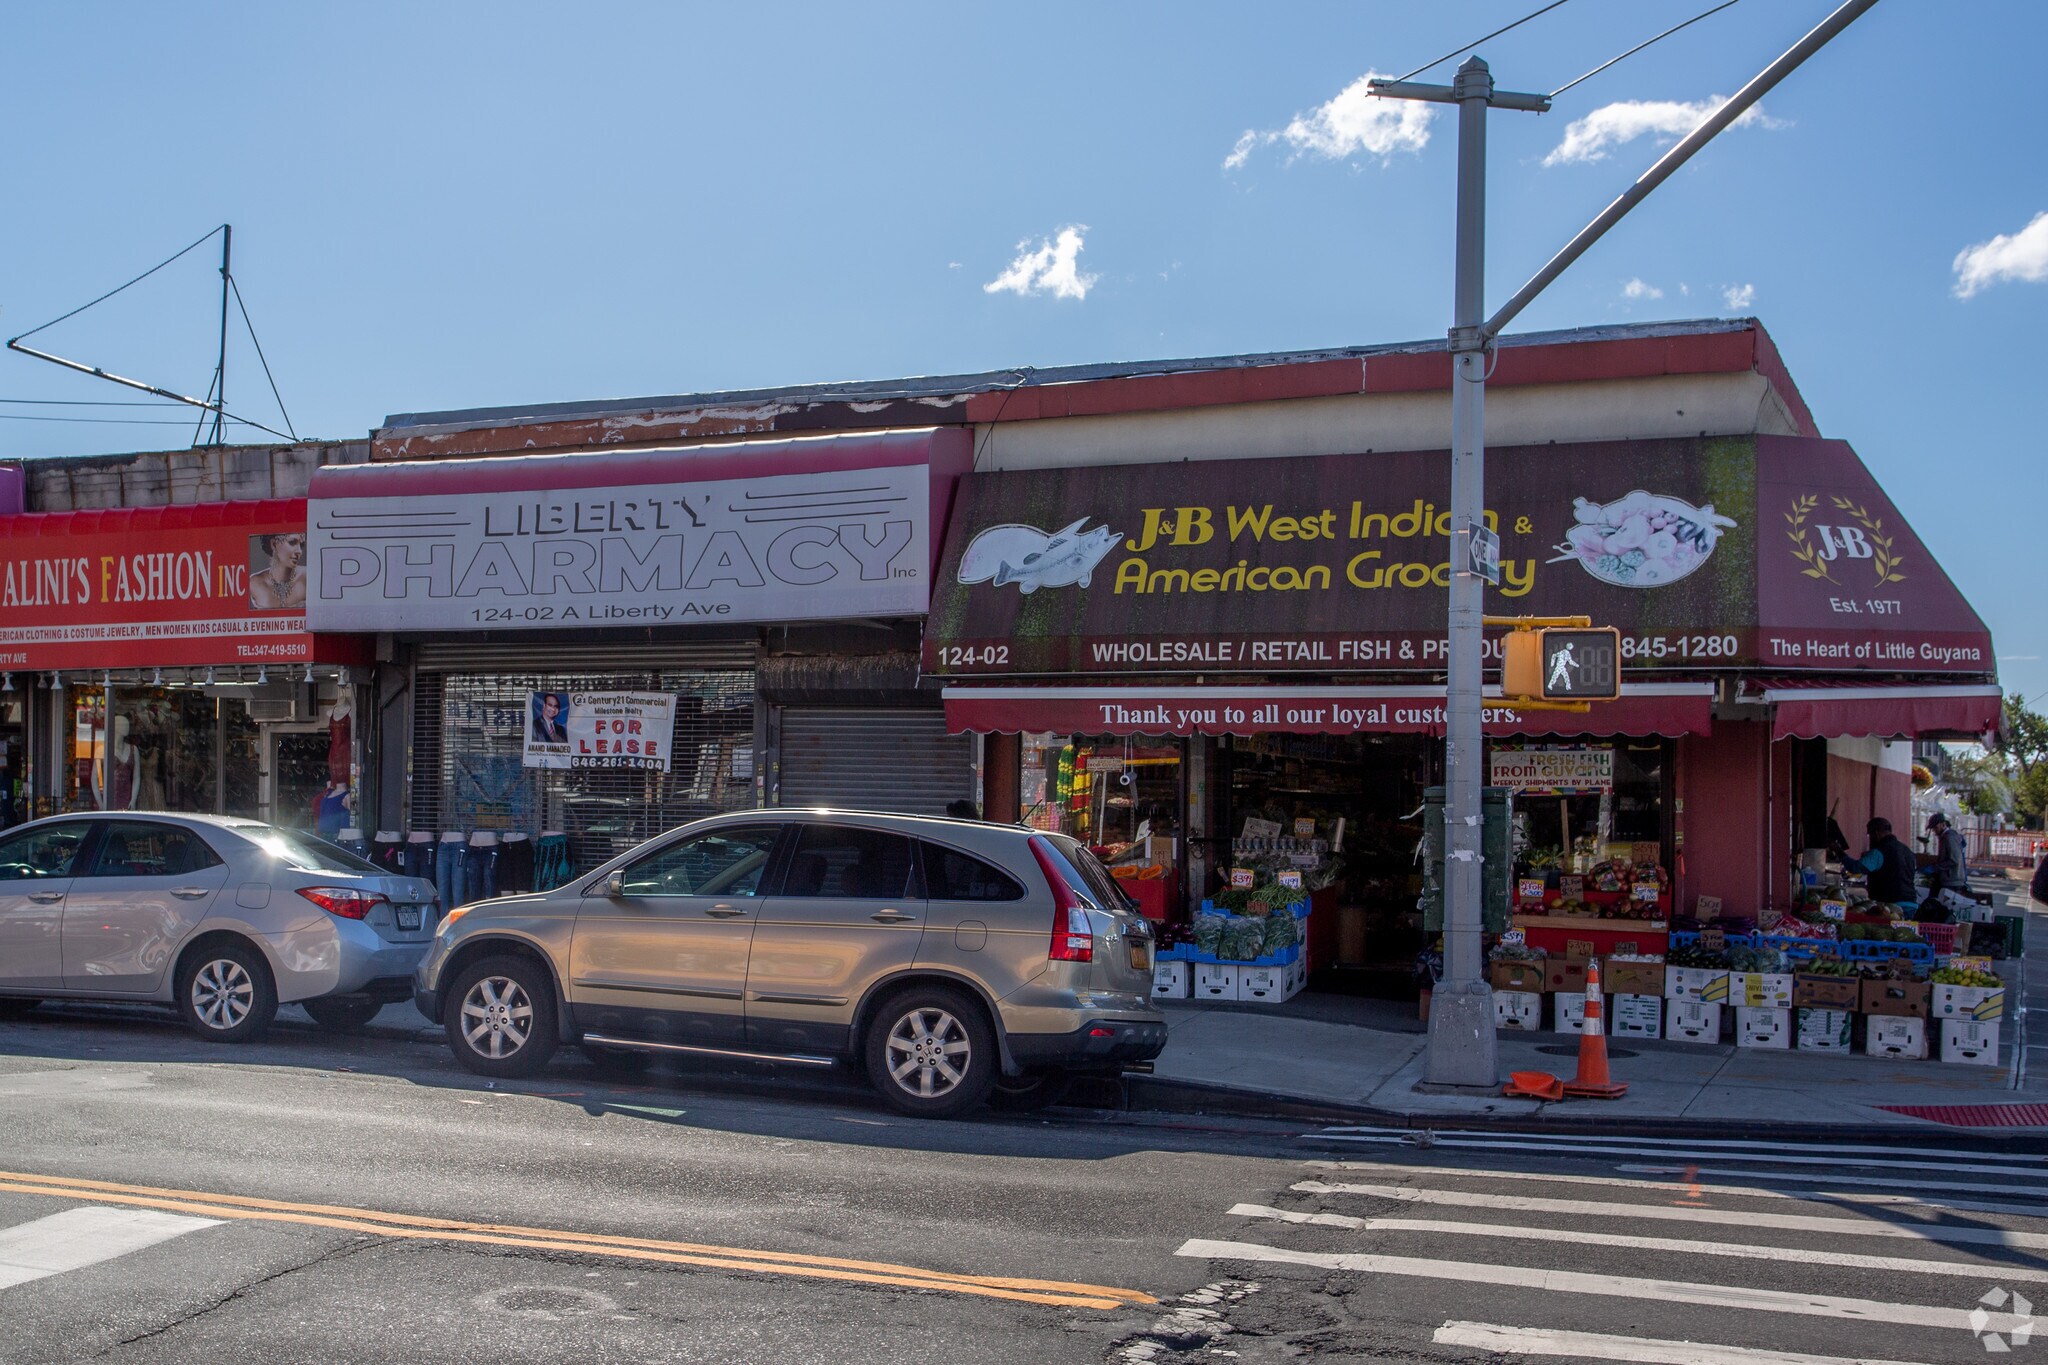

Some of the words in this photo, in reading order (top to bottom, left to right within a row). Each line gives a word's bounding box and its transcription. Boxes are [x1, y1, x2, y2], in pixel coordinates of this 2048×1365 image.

[1226, 503, 1337, 543] West
[1513, 515, 1533, 535] &
[1474, 539, 1487, 562] ONE
[1814, 524, 1874, 561] J&B
[319, 519, 913, 601] PHARMACY
[893, 566, 917, 579] Inc
[0, 556, 91, 607] ALINI'S
[100, 550, 213, 603] FASHION
[217, 564, 246, 598] INC
[1113, 557, 1332, 595] American
[1346, 550, 1536, 598] Grocry
[470, 606, 555, 622] 124-02
[561, 606, 580, 620] A
[588, 602, 674, 621] Liberty
[680, 601, 732, 616] Ave
[1829, 597, 1863, 614] Est.
[1865, 599, 1902, 615] 1977
[25, 628, 62, 641] CLOTHING
[63, 629, 69, 639] &
[70, 627, 105, 639] COSTUME
[145, 625, 162, 636] MEN
[163, 624, 191, 635] WOMEN
[192, 623, 210, 634] KIDS
[211, 622, 242, 633] CASUAL
[243, 621, 249, 632] &
[250, 620, 285, 632] EVENING
[13, 652, 27, 664] AVE
[937, 645, 1009, 666] 124-02
[1092, 641, 1233, 663] WHOLESALE
[1252, 641, 1332, 661] RETAIL
[1338, 640, 1392, 660] FISH
[1398, 639, 1416, 660] &
[1770, 638, 1801, 657] The
[1806, 639, 1851, 658] Heart
[1854, 641, 1871, 658] of
[1875, 641, 1915, 660] Little
[1919, 643, 1981, 664] Guyana
[594, 707, 624, 716] Milestone
[625, 695, 667, 708] Commercial
[1099, 704, 1172, 724] Thank
[1176, 709, 1217, 729] you
[1223, 706, 1246, 724] to
[1252, 704, 1280, 724] all
[1285, 707, 1327, 724] our
[1331, 703, 1388, 729] loyal
[1394, 704, 1523, 725] custoers.
[594, 719, 642, 735] FOR
[579, 739, 658, 757] LEASE
[571, 757, 664, 771] 646-261-1404
[1492, 779, 1523, 787] WEEKLY
[1524, 779, 1569, 787] SHIPMENTS
[1571, 779, 1582, 787] BY
[1584, 779, 1612, 787] PLANE
[1745, 983, 1779, 993] PLANTAINS
